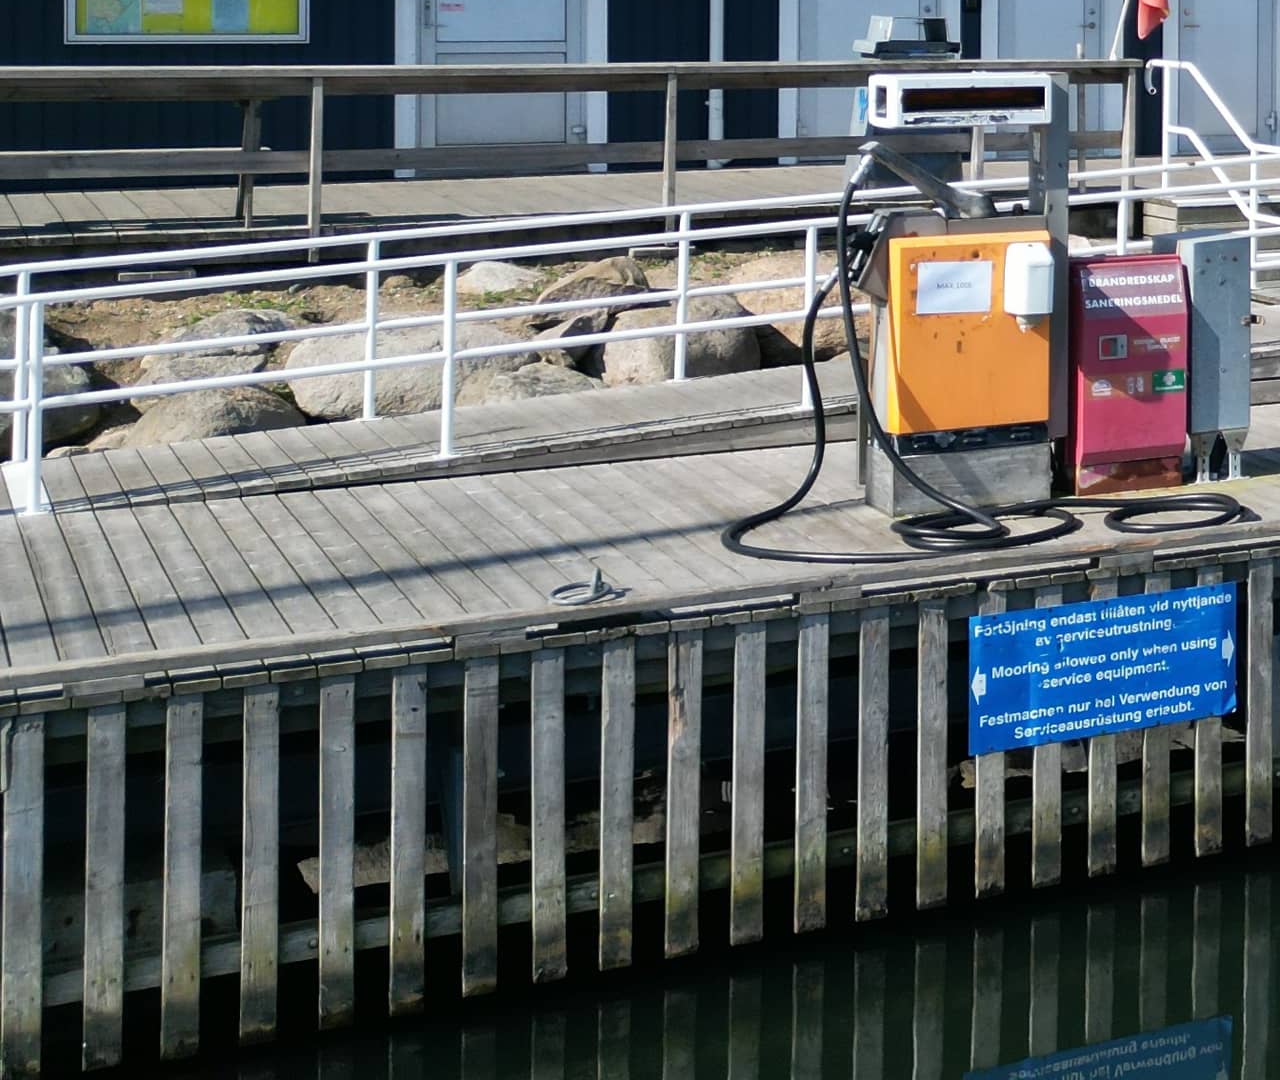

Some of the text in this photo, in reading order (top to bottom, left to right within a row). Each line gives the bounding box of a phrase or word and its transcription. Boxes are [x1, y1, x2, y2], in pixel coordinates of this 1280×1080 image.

[1088, 274, 1175, 288] BRANDREDSKAP
[1085, 294, 1183, 309] SANERINGSMEDEL
[974, 592, 1232, 638] Förtöjning endast tillåten vid nyttjande
[1035, 635, 1053, 647] av
[991, 661, 1050, 679] Mooring
[1110, 647, 1139, 662] only
[1142, 643, 1177, 657] when
[1181, 637, 1217, 651] using
[1042, 660, 1170, 689] service equipment.
[979, 705, 1064, 729] Festmachen
[1068, 701, 1091, 714] nur
[1119, 684, 1200, 706] Verwendung
[1204, 680, 1227, 692] von
[1013, 710, 1142, 739] Serviceausrüstung
